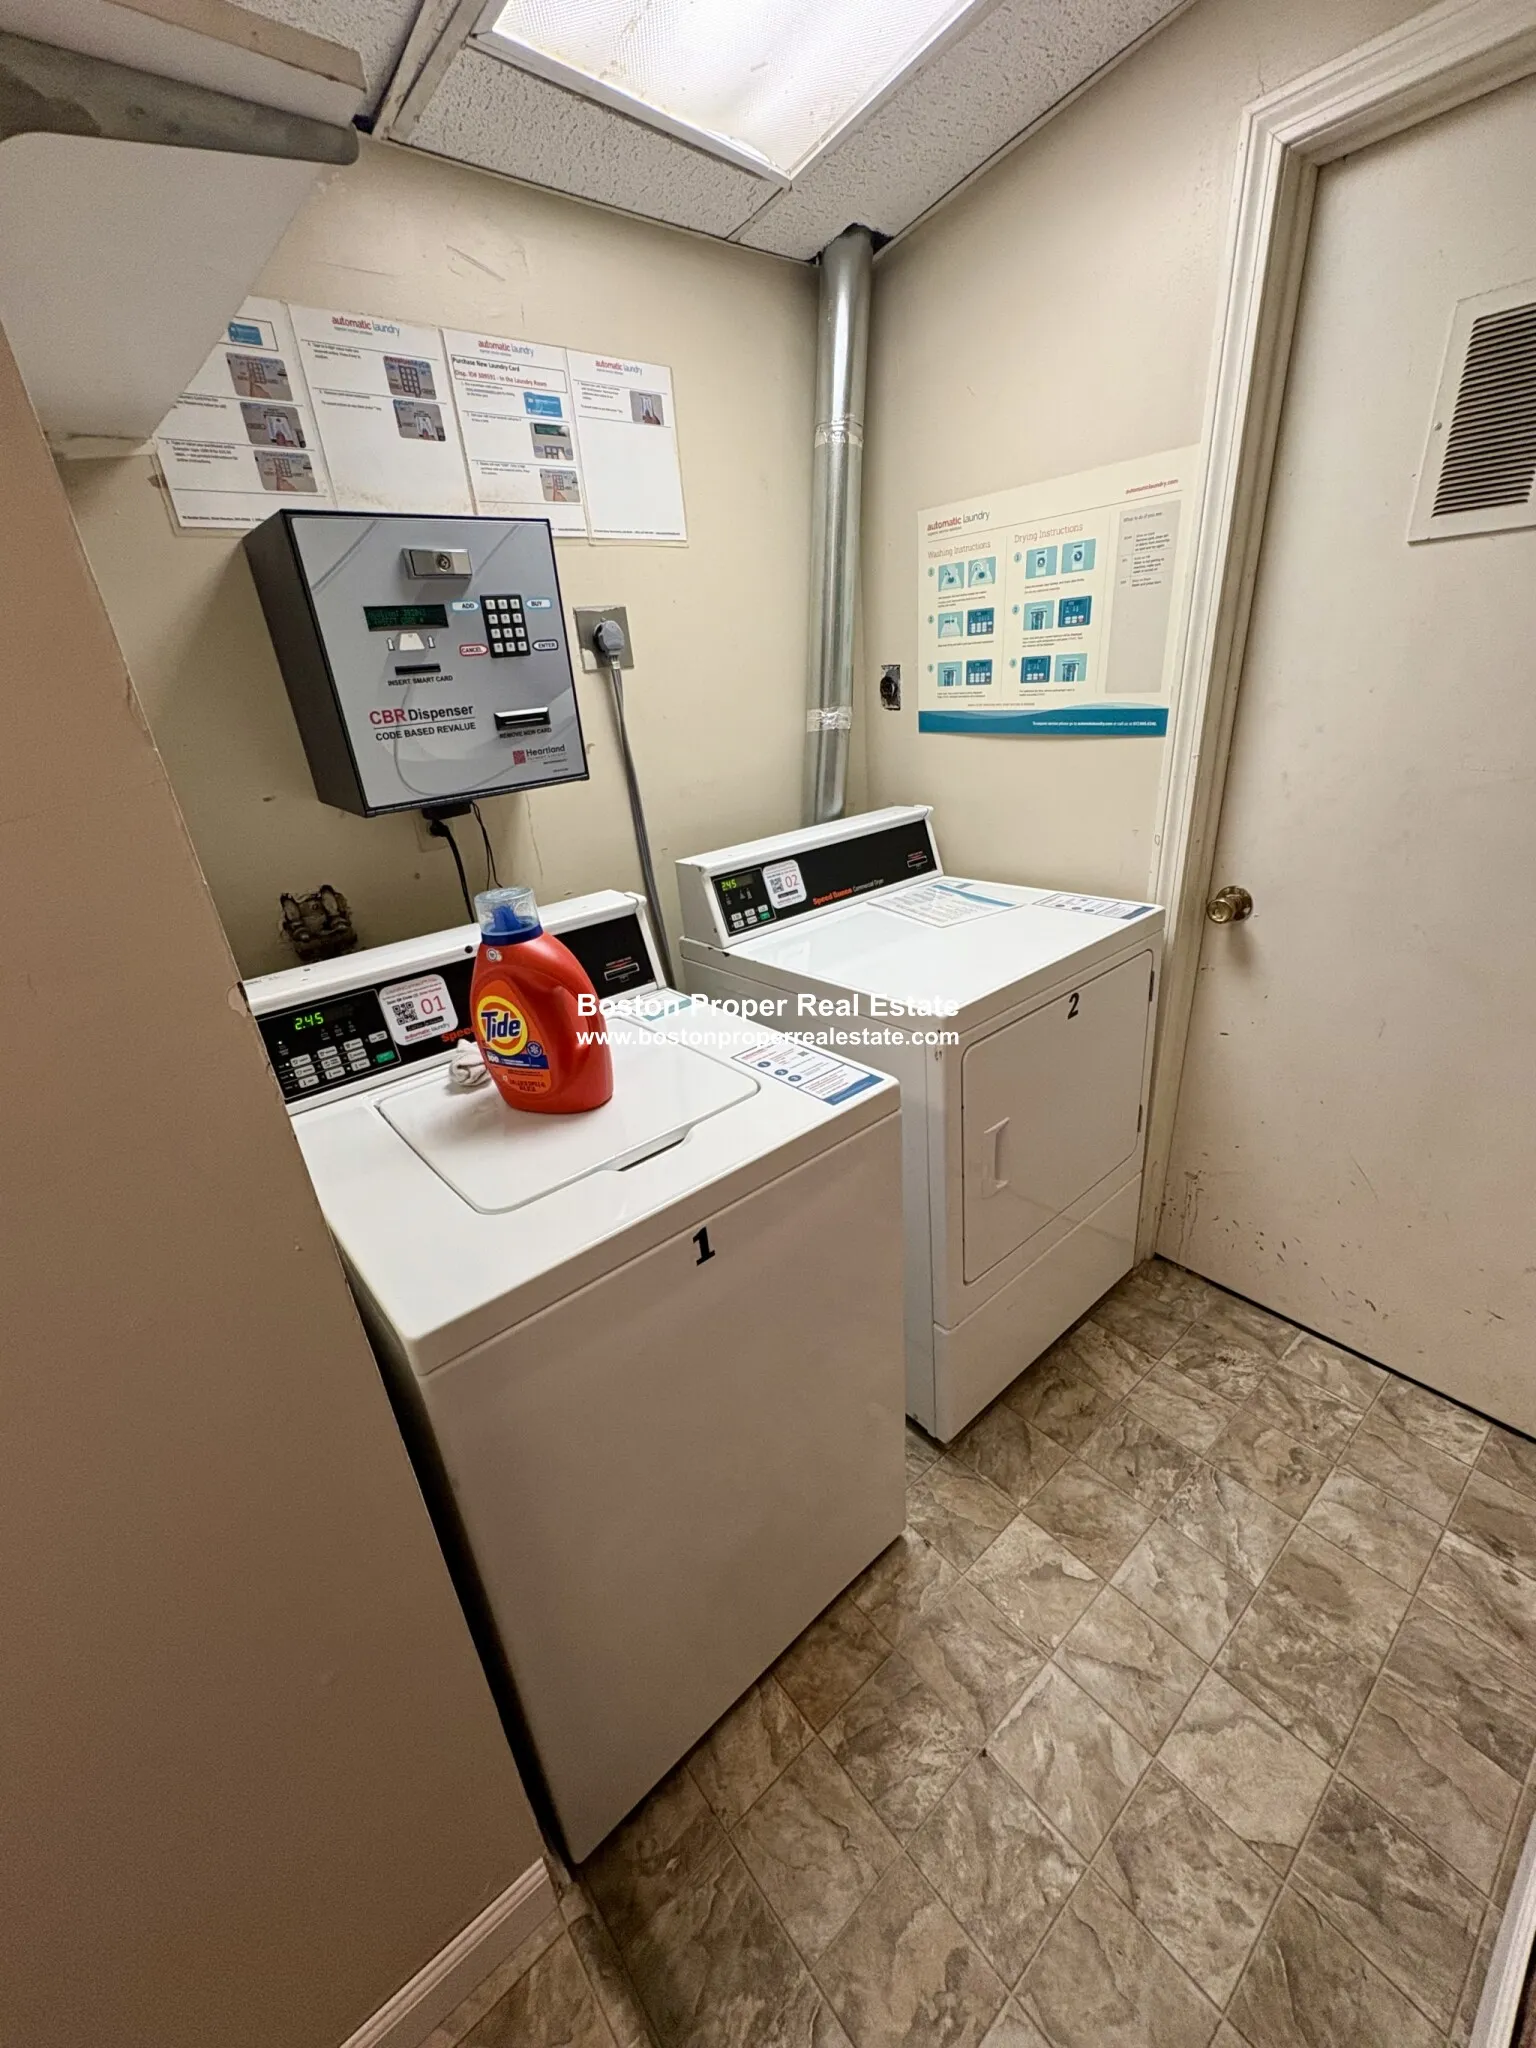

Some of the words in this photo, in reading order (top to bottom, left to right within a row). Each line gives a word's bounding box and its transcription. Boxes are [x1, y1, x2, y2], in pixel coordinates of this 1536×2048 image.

[332, 316, 372, 330] automatic
[372, 320, 400, 337] laundry
[478, 340, 511, 352] automatic
[511, 343, 534, 358] laundry
[452, 357, 475, 366] Purchase
[476, 360, 487, 368] New
[489, 362, 508, 372] Laundry
[508, 364, 520, 372] Card
[595, 360, 623, 371] automatic
[623, 363, 642, 376] laundry
[514, 376, 533, 387] Laundry
[927, 516, 962, 531] automatic
[963, 510, 990, 524] laundry
[1014, 531, 1038, 543] Drying
[1039, 523, 1084, 539] Instructions
[928, 548, 954, 559] Washing
[954, 541, 991, 554] Instructions
[462, 601, 475, 609] ADD
[531, 599, 542, 607] BUY
[461, 645, 483, 653] CANCEL
[387, 678, 411, 687] INSERT
[412, 676, 434, 684] SMART
[435, 675, 454, 683] CARD
[369, 708, 408, 725] CBR
[408, 705, 474, 721] Dispenser
[375, 730, 403, 741] CODE
[404, 727, 435, 738] BASED
[437, 722, 476, 734] REVALUE
[500, 731, 523, 739] REMOVE
[526, 744, 565, 756] Heartland
[785, 874, 800, 888] 02
[812, 892, 833, 905] Speed
[421, 995, 446, 1015] 01
[1067, 992, 1080, 1020] 2
[404, 1028, 430, 1040] automatic
[430, 1022, 450, 1032] laundry
[481, 1011, 521, 1042] Tide
[692, 1226, 716, 1266] 1
